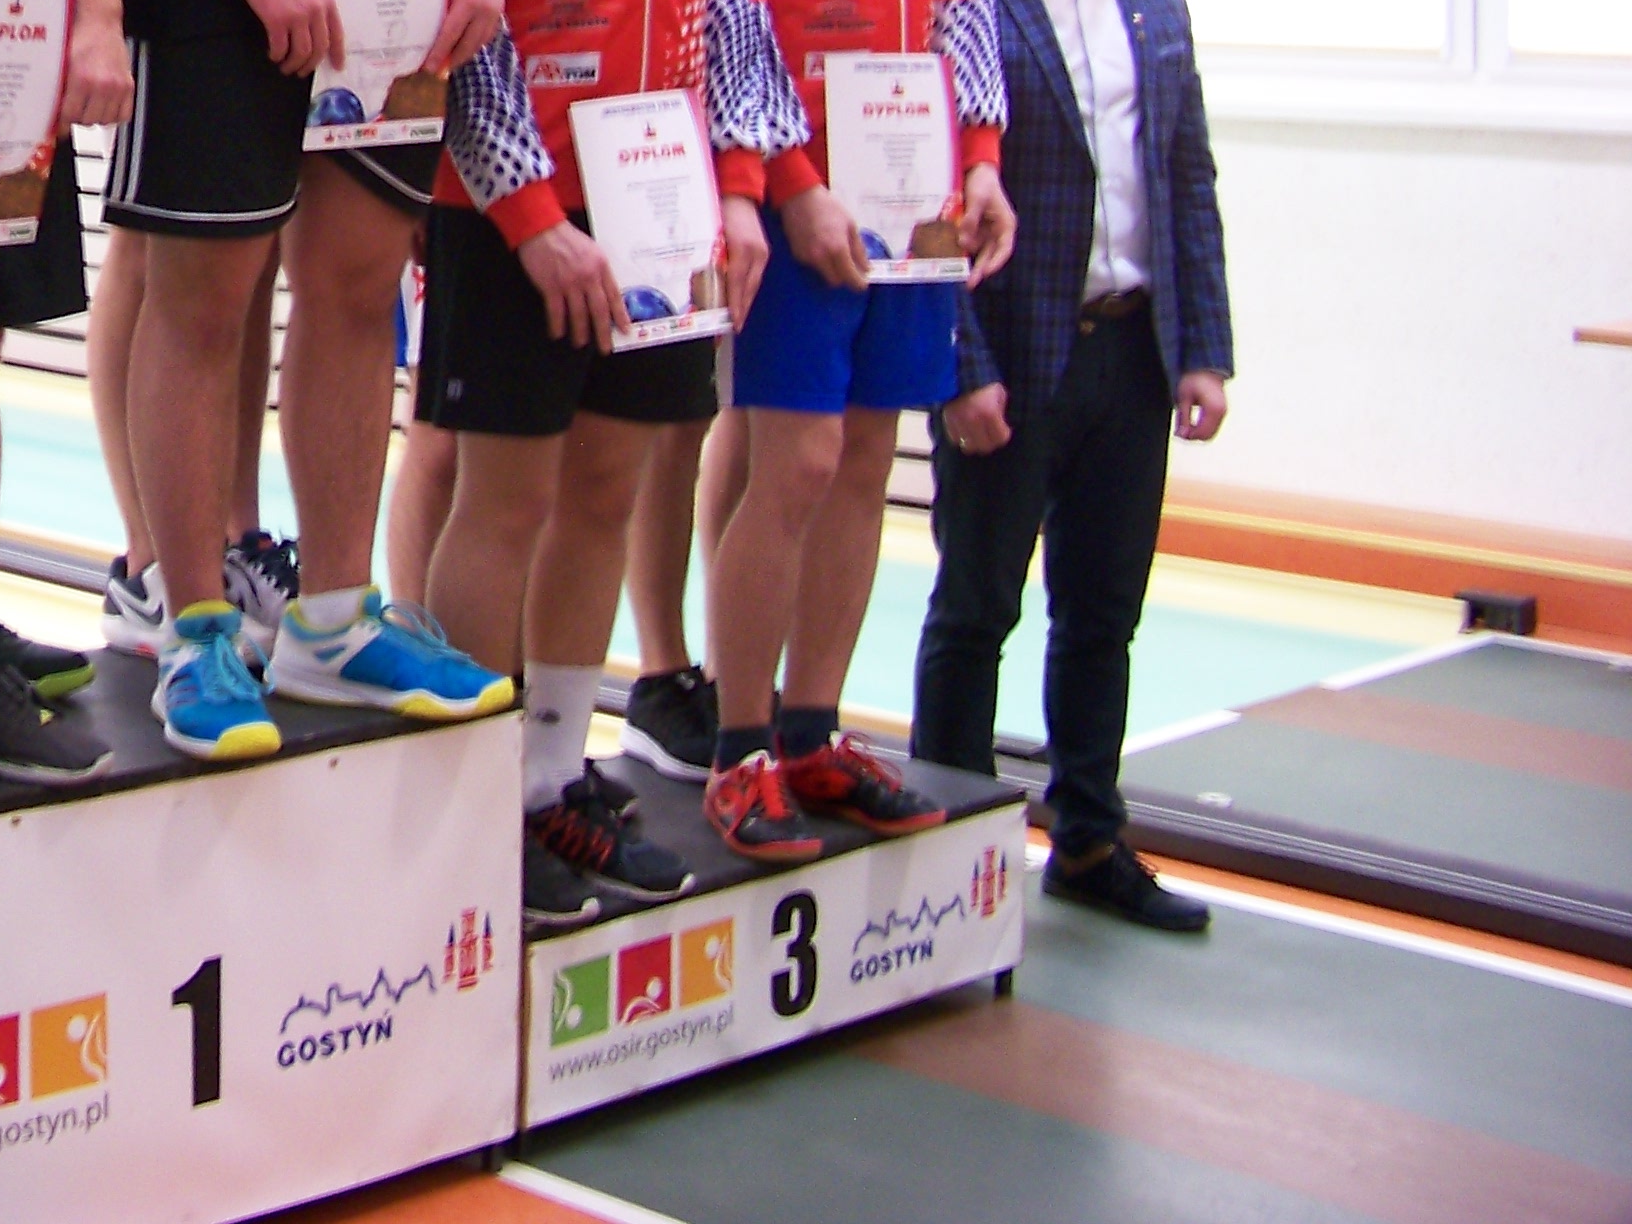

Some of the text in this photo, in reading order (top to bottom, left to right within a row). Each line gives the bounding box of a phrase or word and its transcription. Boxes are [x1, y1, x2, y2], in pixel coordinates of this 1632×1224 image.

[771, 889, 817, 1017] 3
[172, 956, 222, 1109] 1
[276, 1008, 393, 1070] GOSTYŃ
